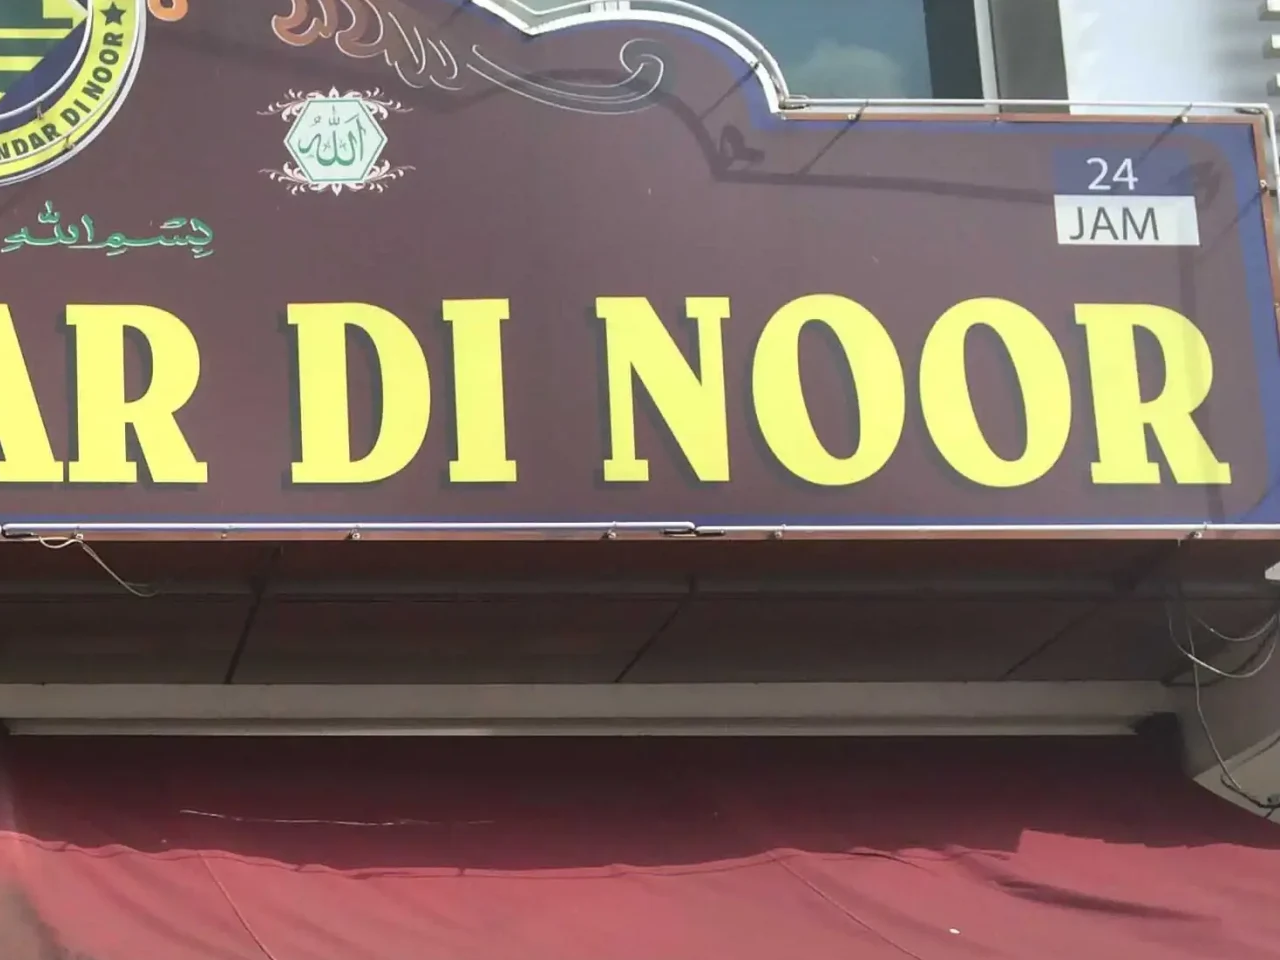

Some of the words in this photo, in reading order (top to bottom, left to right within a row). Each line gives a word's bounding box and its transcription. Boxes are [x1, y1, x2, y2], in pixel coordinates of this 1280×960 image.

[60, 99, 92, 127] DI
[82, 32, 124, 100] NOOR
[1086, 157, 1139, 190] 24
[1069, 206, 1160, 240] JAM
[287, 298, 517, 484] DI
[595, 293, 1232, 487] NOOR
